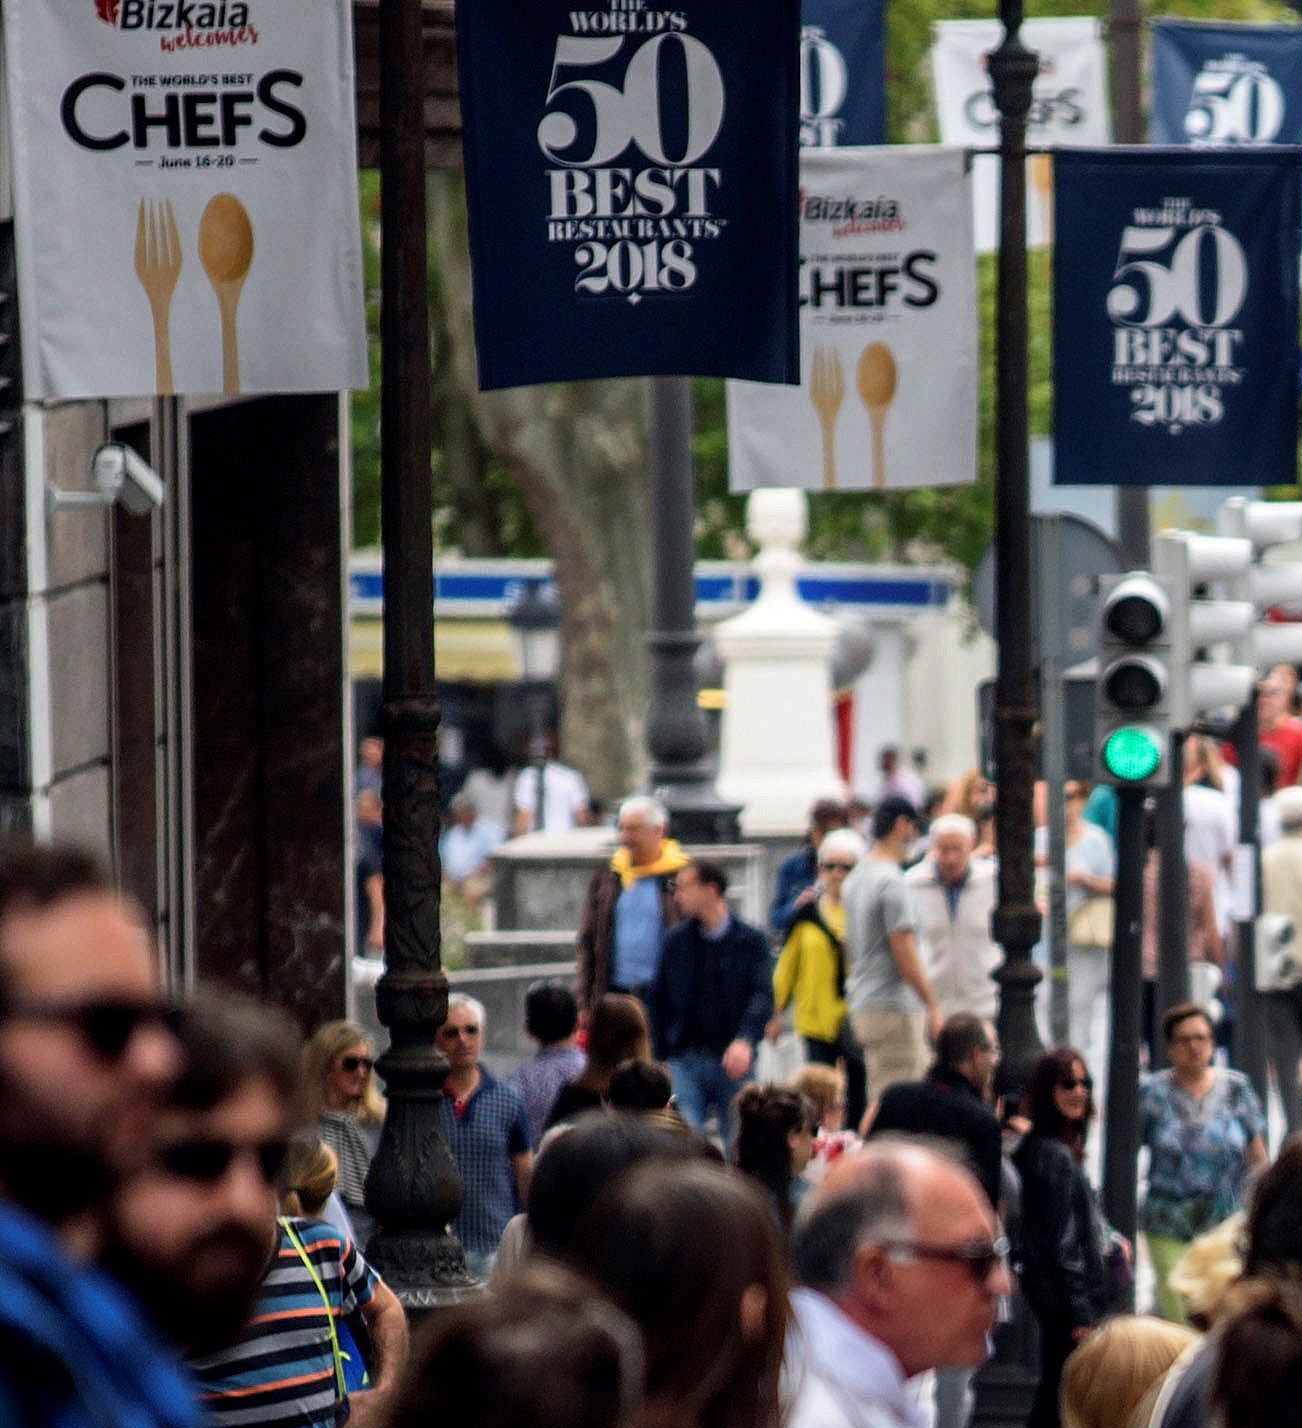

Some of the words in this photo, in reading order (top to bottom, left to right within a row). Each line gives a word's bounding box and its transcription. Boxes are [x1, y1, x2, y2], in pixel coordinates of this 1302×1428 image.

[120, 0, 249, 30] Bizkaia
[568, 11, 689, 33] WORLD'S
[130, 74, 158, 87] THE
[159, 73, 219, 87] WORLD'S
[221, 72, 254, 85] BEST
[537, 31, 725, 168] 50
[60, 68, 307, 151] CHEFS
[1184, 70, 1285, 145] 50
[545, 168, 722, 220] BEST
[574, 239, 697, 293] 2018
[798, 248, 940, 308] HEFS
[1106, 225, 1249, 328] 50
[1111, 328, 1244, 366] BEST
